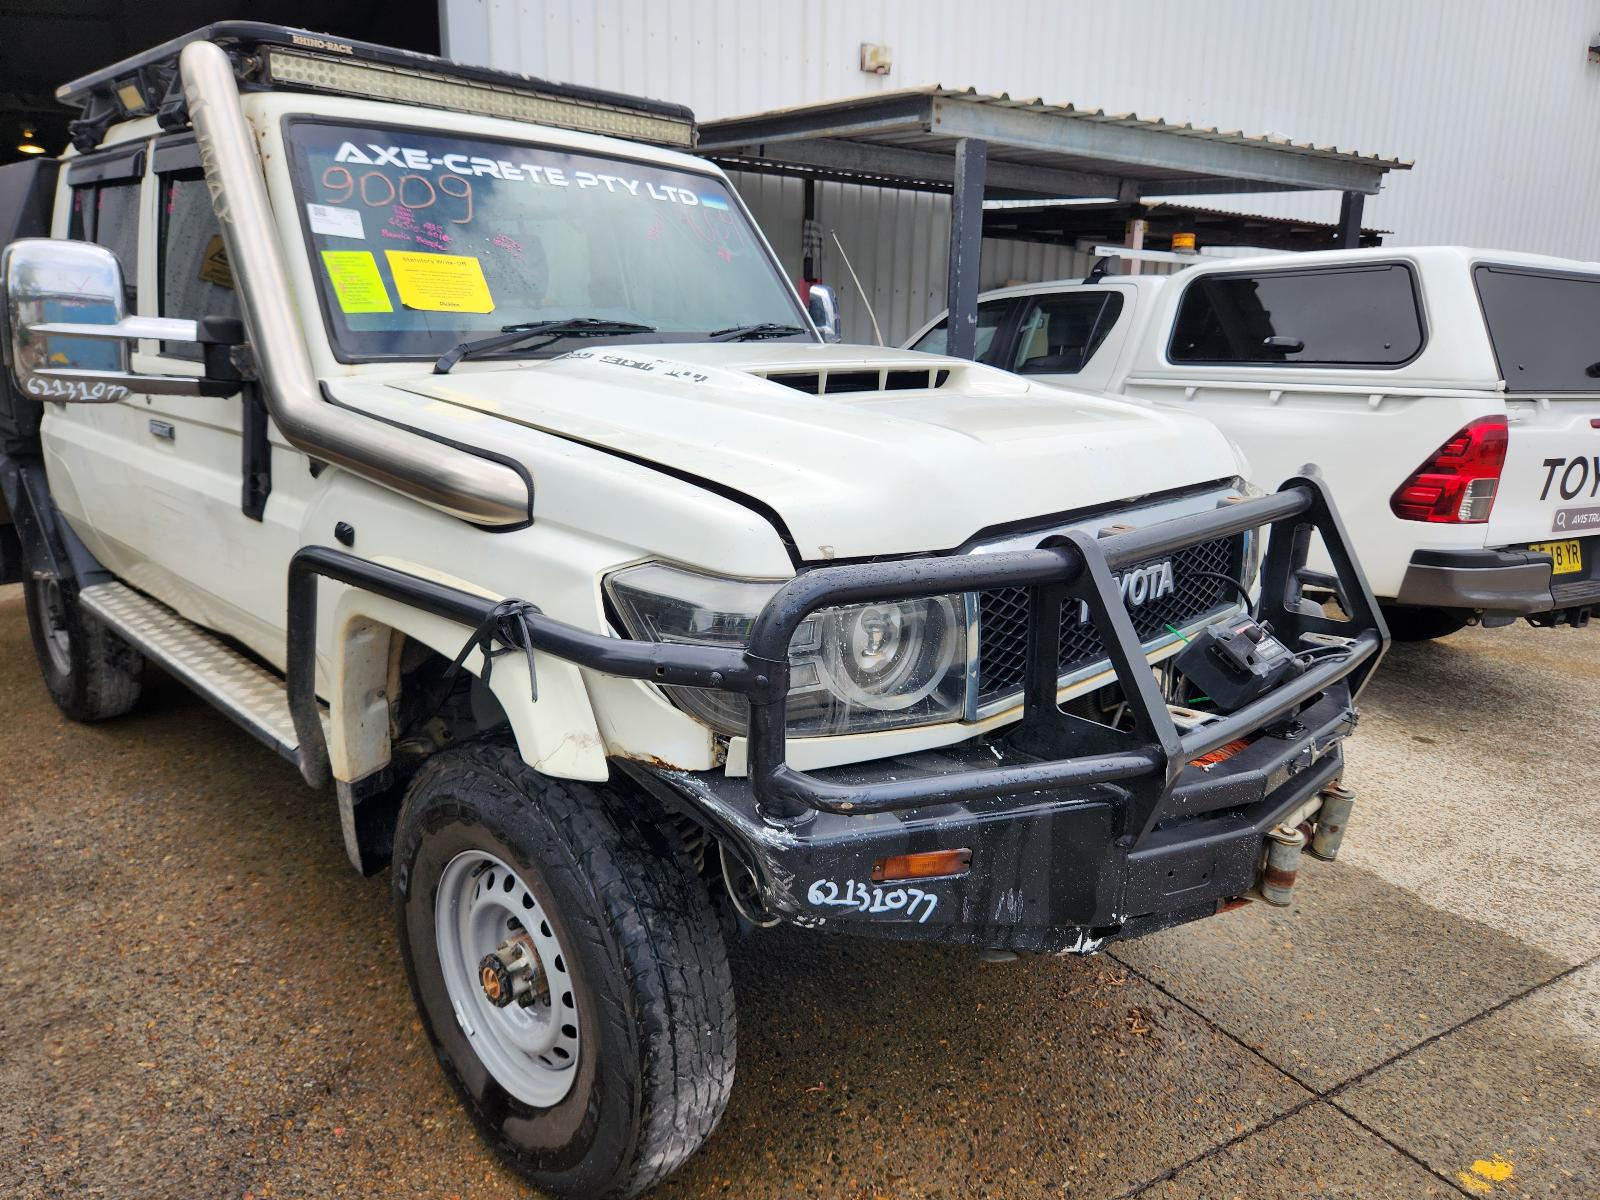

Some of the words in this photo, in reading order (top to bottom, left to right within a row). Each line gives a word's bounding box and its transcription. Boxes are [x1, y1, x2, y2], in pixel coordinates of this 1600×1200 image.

[292, 35, 353, 55] RHINO-RACK
[322, 166, 473, 225] 9009
[334, 141, 569, 187] AXE-CRETE
[574, 171, 640, 196] PTY
[646, 181, 699, 206] LTD
[1571, 514, 1588, 525] AVIS
[807, 878, 938, 924] 62131077
